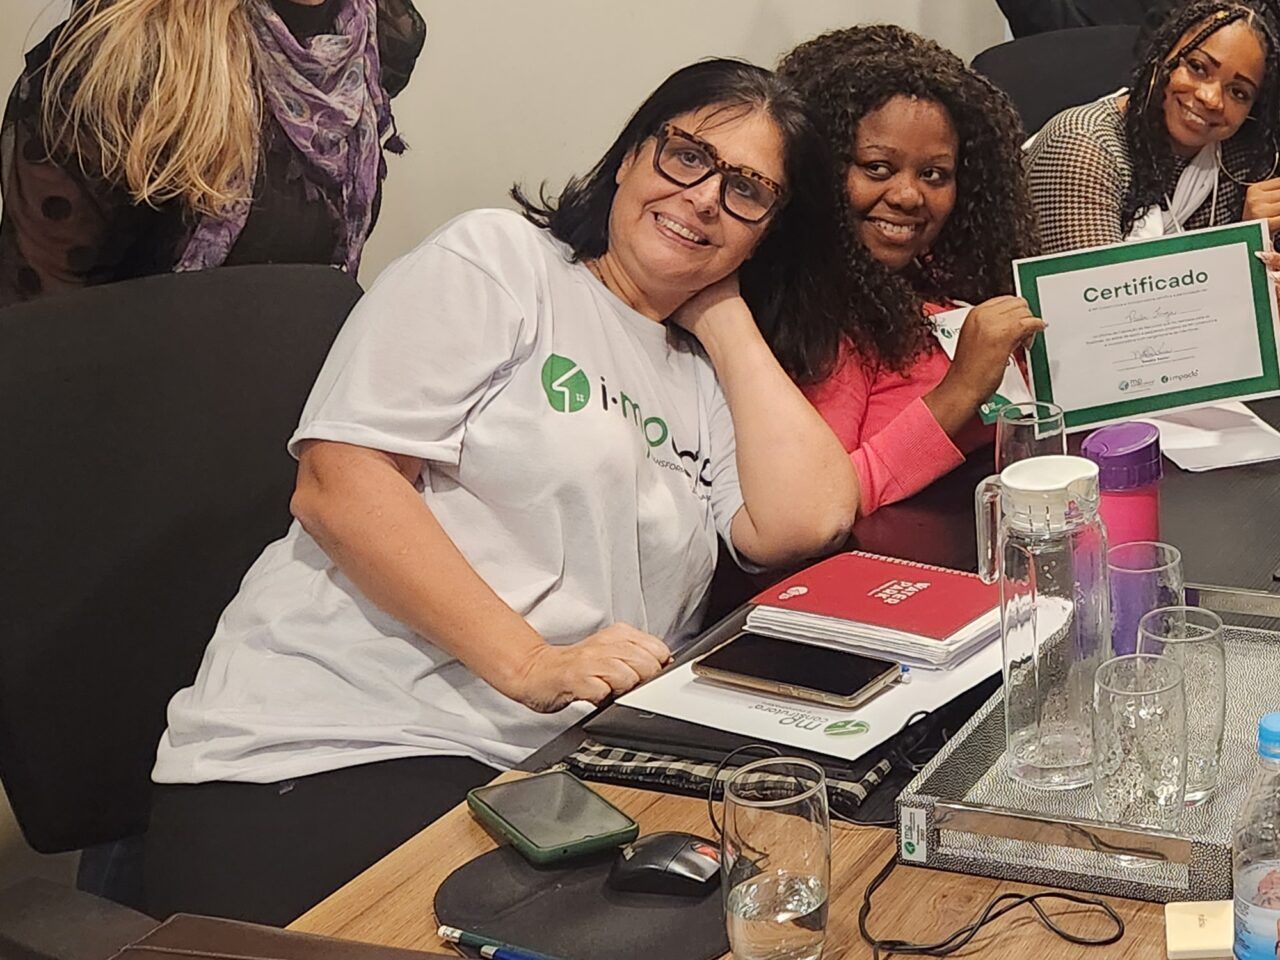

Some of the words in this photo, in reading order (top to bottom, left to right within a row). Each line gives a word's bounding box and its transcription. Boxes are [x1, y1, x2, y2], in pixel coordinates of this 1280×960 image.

[1083, 269, 1209, 302] Certificado
[874, 581, 914, 600] PARK
[883, 582, 931, 605] WATER
